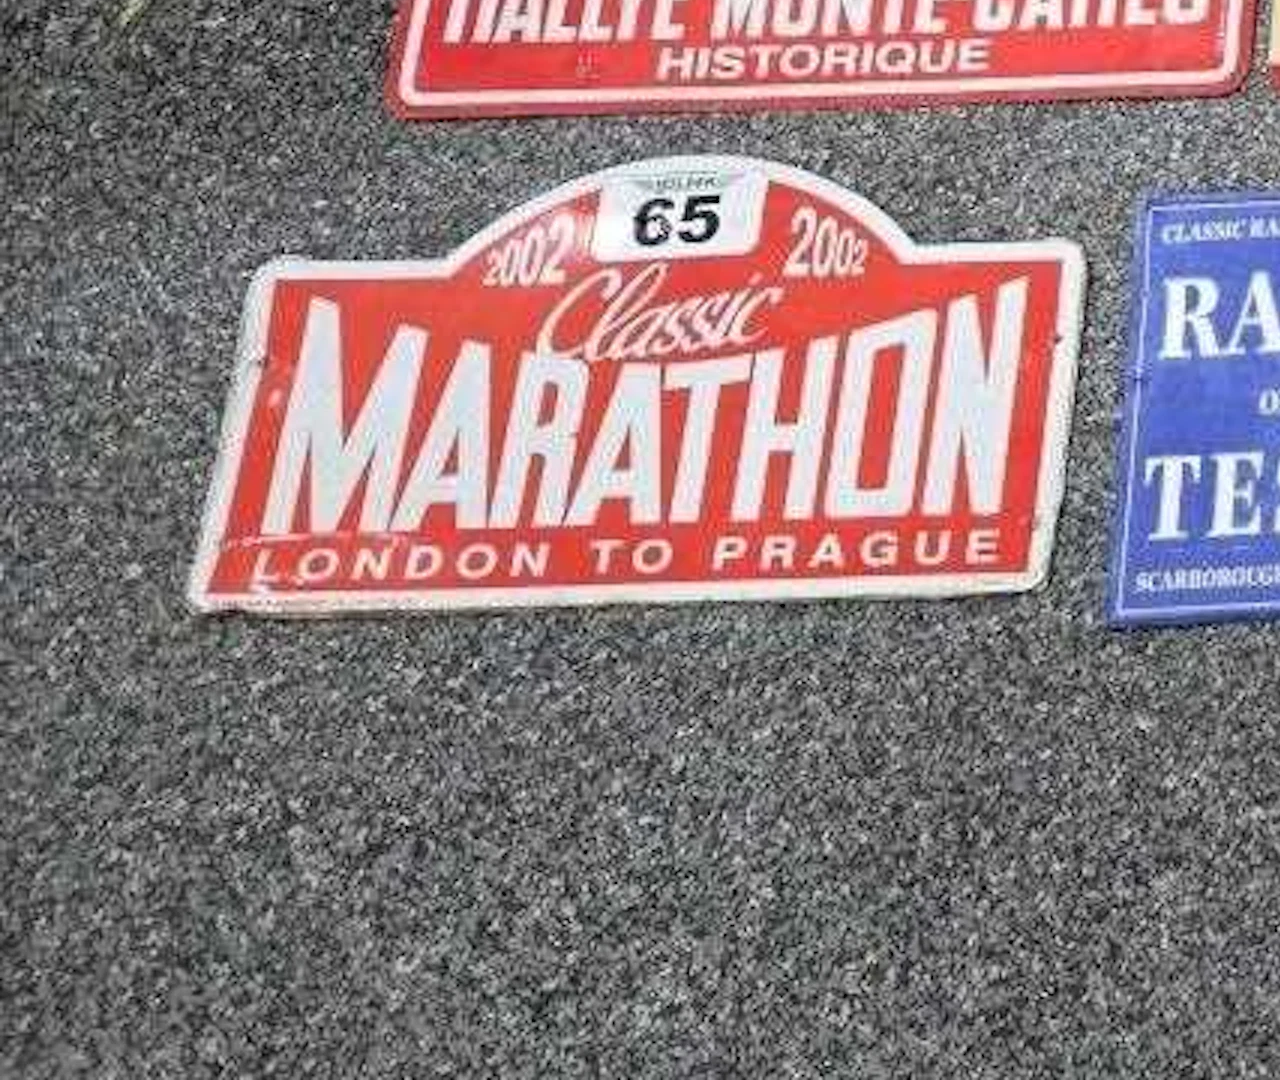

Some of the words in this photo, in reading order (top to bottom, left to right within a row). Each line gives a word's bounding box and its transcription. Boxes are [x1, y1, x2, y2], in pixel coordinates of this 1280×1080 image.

[655, 38, 991, 83] HISTORIQUE
[634, 195, 721, 246] 65
[782, 206, 868, 279] 2002
[1162, 219, 1243, 244] CLASSIC
[482, 217, 577, 287] 2002
[536, 262, 785, 362] Classic
[261, 277, 1029, 536] MARATHON
[255, 539, 549, 582] LONDON
[594, 539, 674, 572] TO
[711, 529, 1000, 570] PRAGUE
